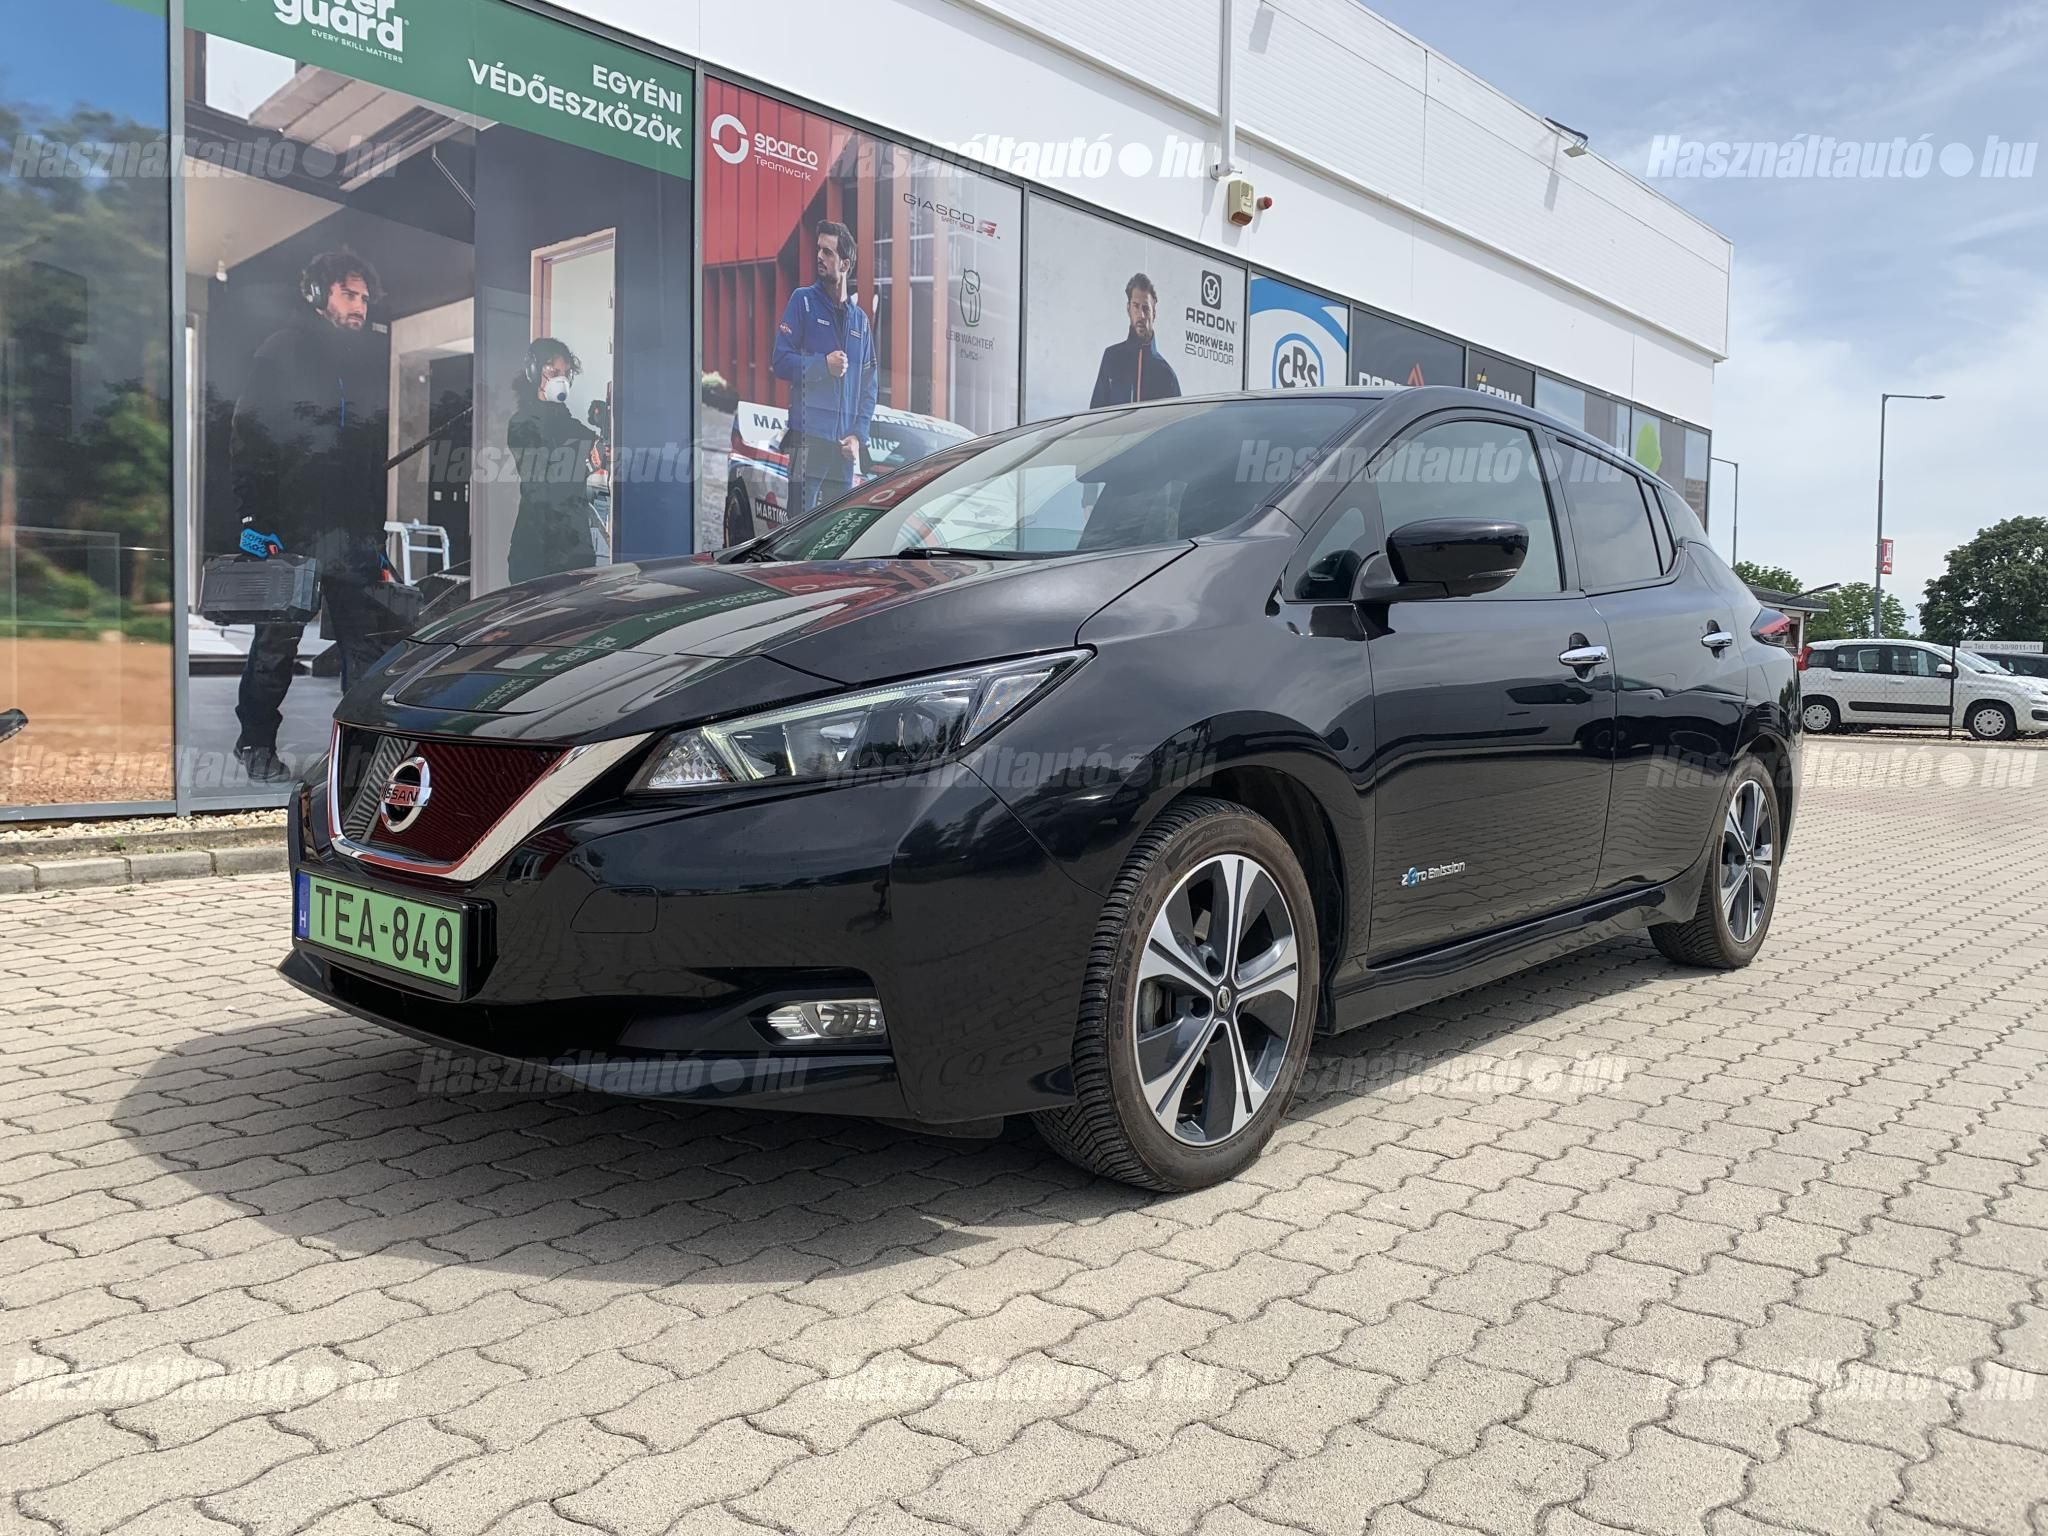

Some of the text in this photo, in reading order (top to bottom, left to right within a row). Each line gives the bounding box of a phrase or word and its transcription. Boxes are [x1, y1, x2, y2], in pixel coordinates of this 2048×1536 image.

[274, 0, 404, 52] guard
[311, 28, 404, 65] EVERY SKILL MATTERS
[467, 57, 683, 149] VÉDŐESZKÖZÖK
[592, 63, 683, 115] EGYÉNI
[753, 153, 812, 182] Teamwork
[754, 132, 819, 168] sparco
[903, 192, 976, 226] GIASCO
[1186, 306, 1236, 335] ARDON
[1185, 330, 1234, 354] WORKWEAR
[1197, 345, 1234, 366] OUTDOOR
[1278, 345, 1318, 388] CRS
[299, 884, 453, 975] H TEA-849
